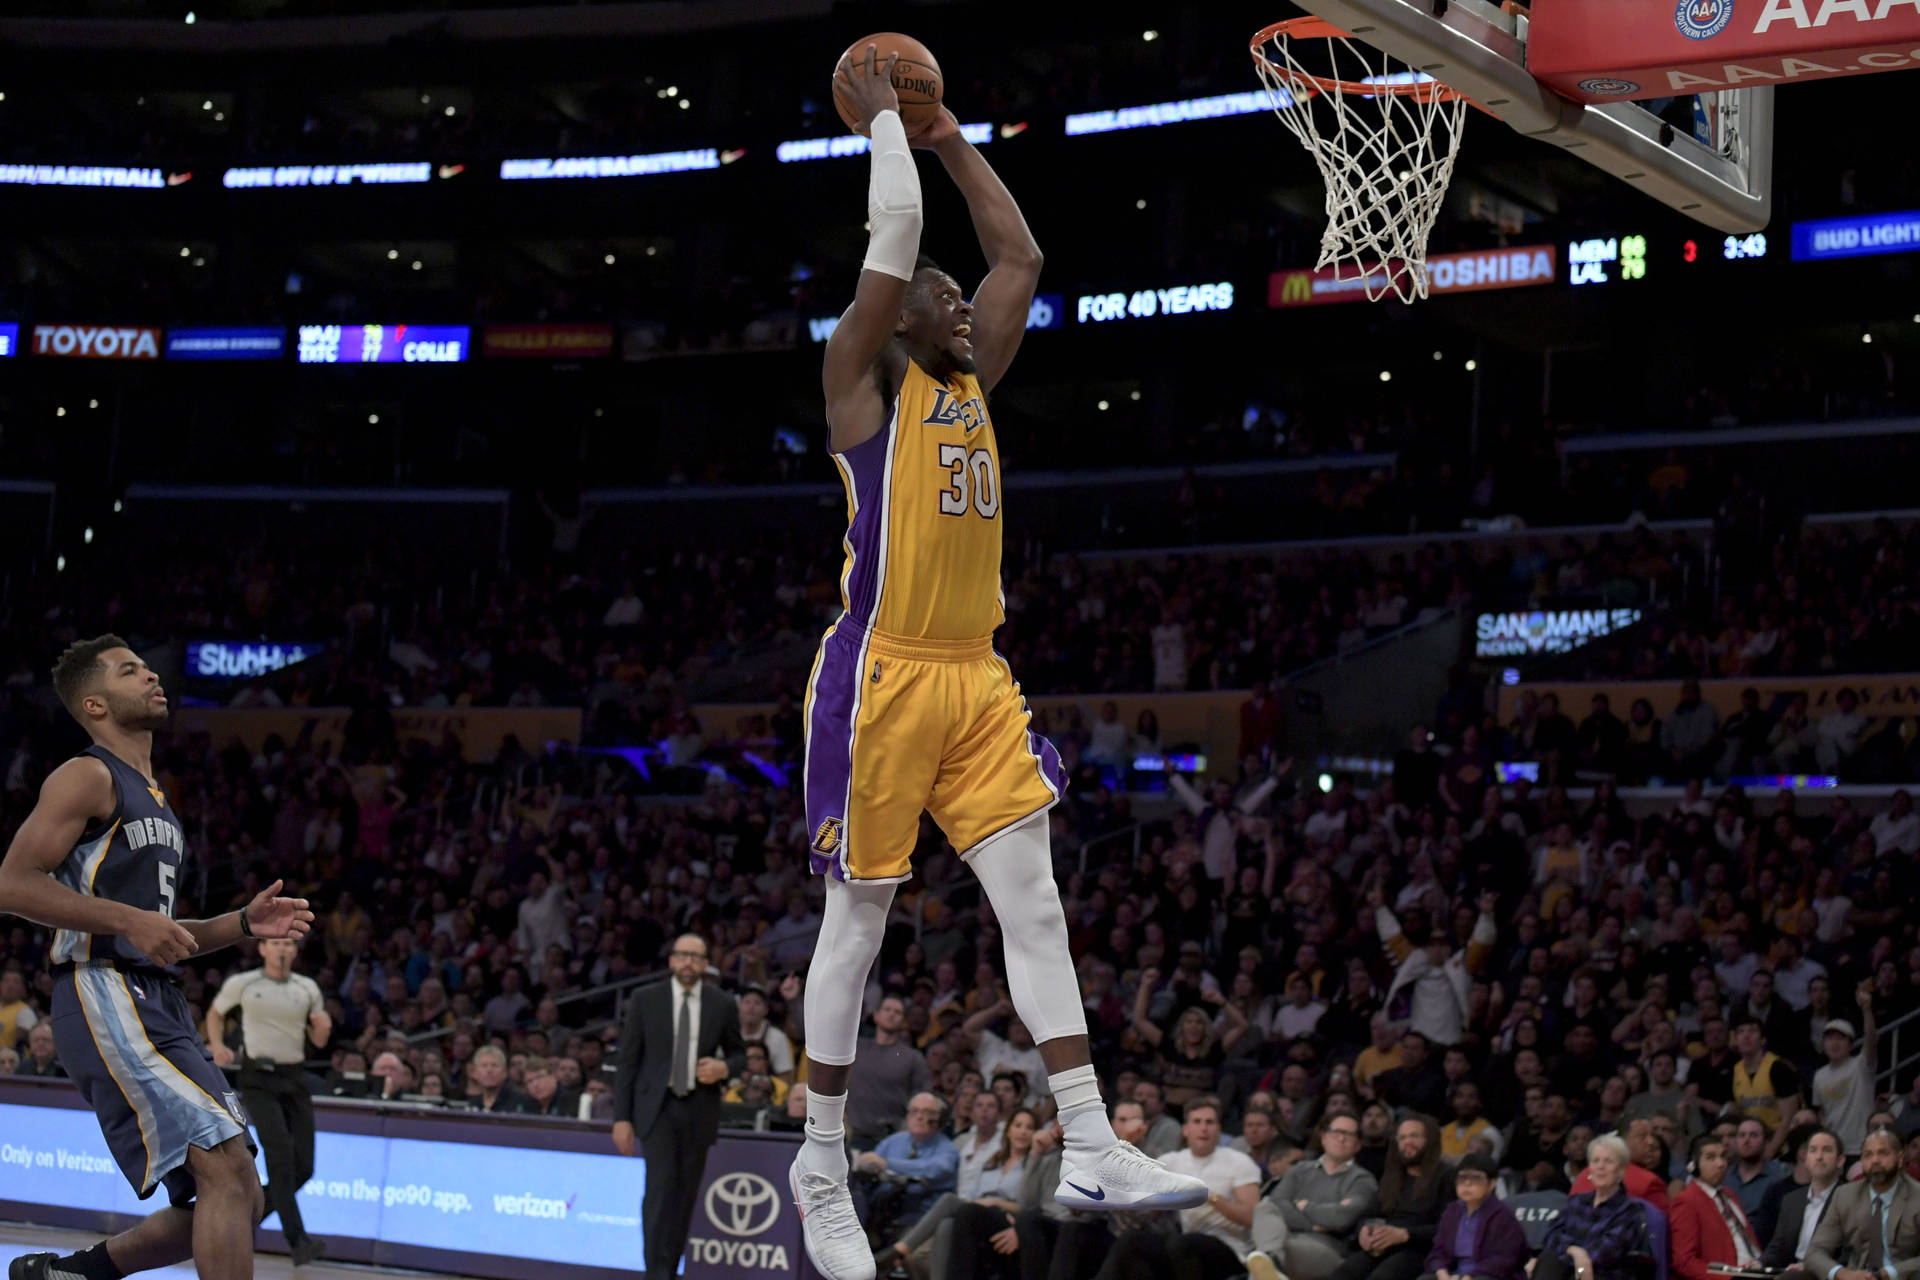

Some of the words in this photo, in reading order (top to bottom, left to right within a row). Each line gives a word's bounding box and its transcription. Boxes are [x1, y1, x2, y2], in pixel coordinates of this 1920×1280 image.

[1676, 11, 1701, 39] SOUTHERN
[1702, 6, 1732, 38] CALIFORNIA
[1684, 240, 1697, 262] 3
[1814, 227, 1860, 251] BUD
[1418, 251, 1552, 290] TOSHIBA
[1078, 295, 1127, 323] FOR
[1128, 291, 1157, 316] 40
[1157, 282, 1234, 314] YEARS
[35, 325, 159, 358] TOYOTA
[939, 443, 999, 519] 30
[1476, 612, 1529, 640] SAN
[158, 861, 176, 918] 5
[1, 1144, 35, 1170] Only
[36, 1150, 54, 1167] on
[55, 1149, 116, 1175] Verizon.
[328, 1183, 351, 1200] on
[352, 1179, 380, 1203] the
[384, 1184, 431, 1208] go90
[432, 1190, 472, 1215] app.
[494, 1192, 566, 1219] verizon
[688, 1237, 789, 1271] TOYOTA
